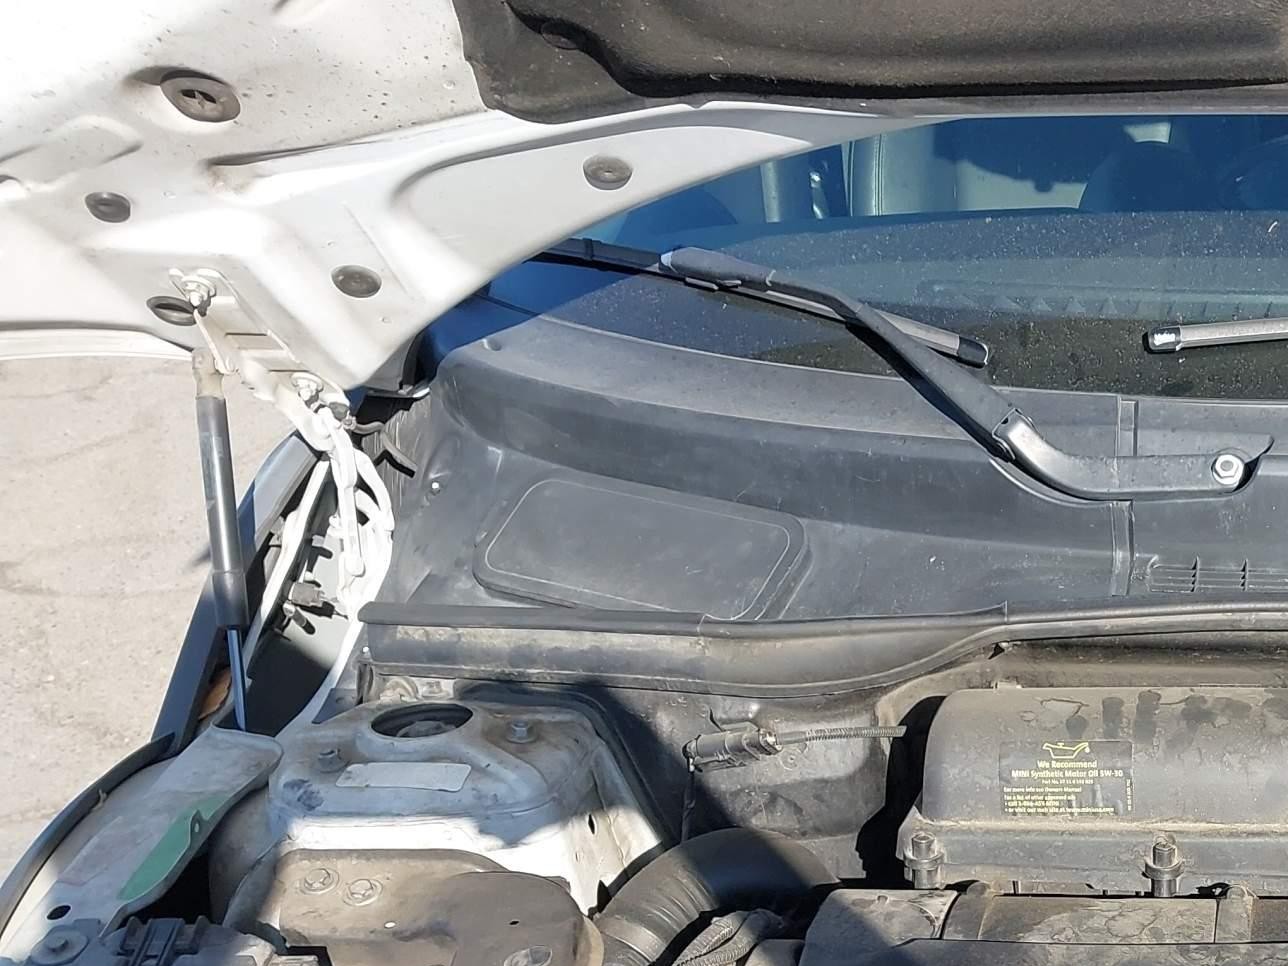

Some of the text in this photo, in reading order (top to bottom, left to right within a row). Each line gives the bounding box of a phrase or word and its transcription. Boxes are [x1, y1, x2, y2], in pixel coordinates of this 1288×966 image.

[1037, 760, 1097, 769] We Recommend
[1011, 769, 1124, 779] MINI Synthetic Motor Oil 5W-30
